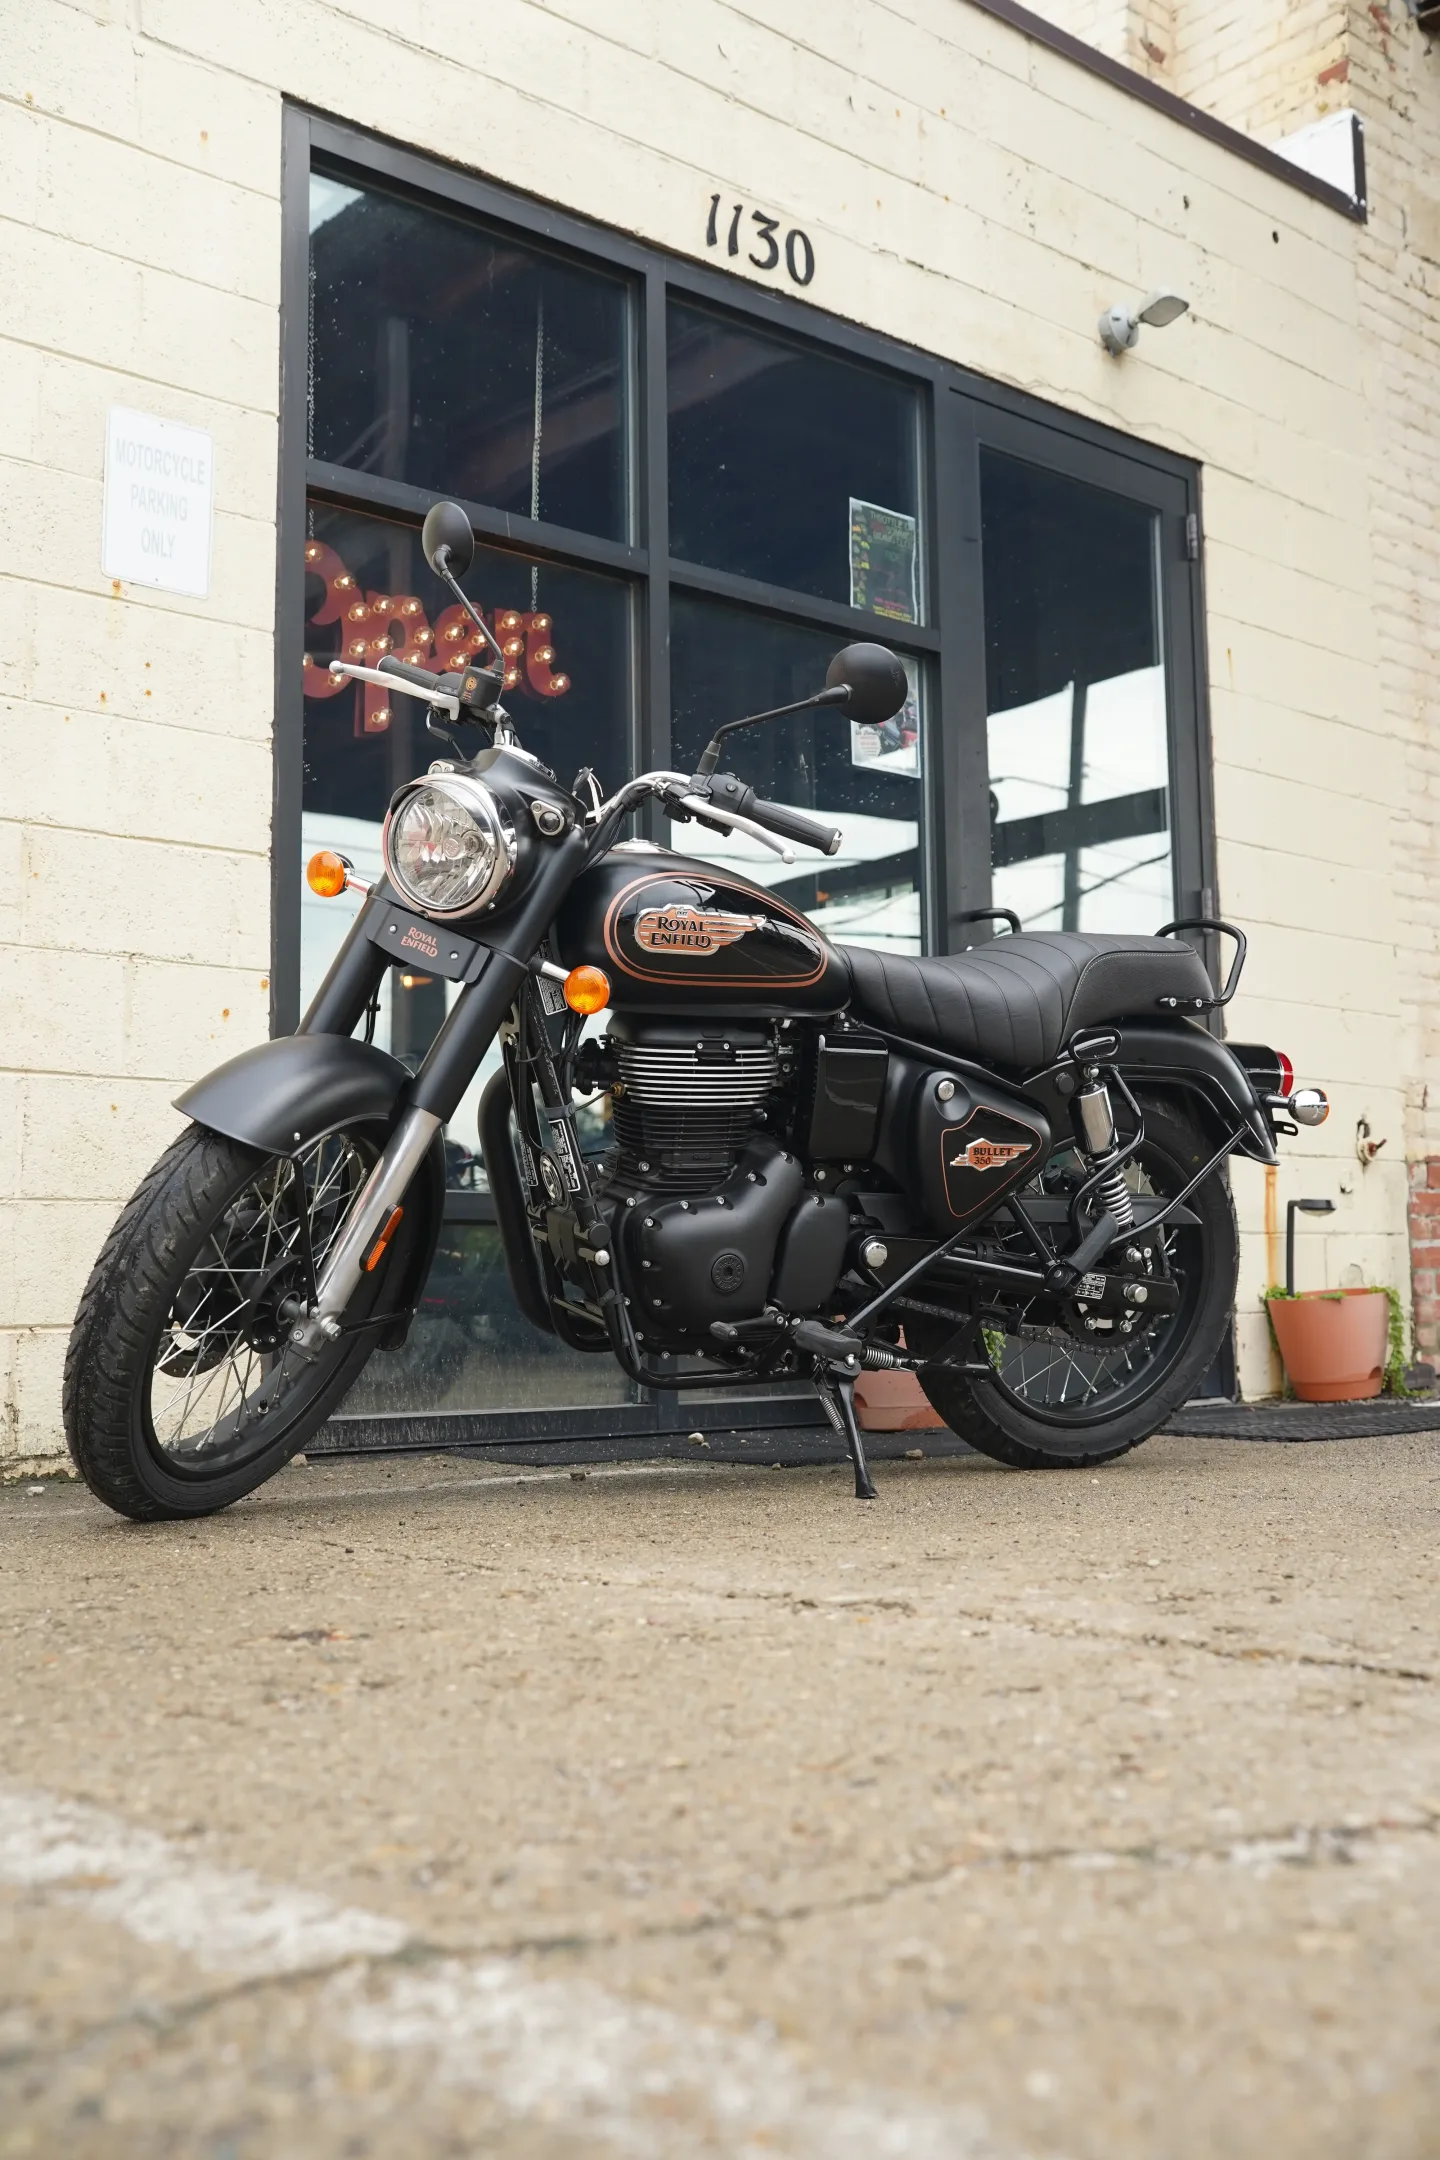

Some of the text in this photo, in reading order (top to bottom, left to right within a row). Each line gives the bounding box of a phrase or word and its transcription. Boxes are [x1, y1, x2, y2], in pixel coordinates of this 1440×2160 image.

[706, 193, 815, 287] 1130
[115, 437, 206, 486] MOTORCYCLE
[130, 483, 188, 522] PARKING
[140, 525, 177, 559] ONLY
[657, 916, 707, 932] ROYAL
[401, 935, 438, 957] ENFIELD
[408, 926, 437, 947] ROYAL
[651, 932, 711, 949] ENFIELD
[973, 1147, 1012, 1156] BULLET
[974, 1156, 991, 1165] 350
